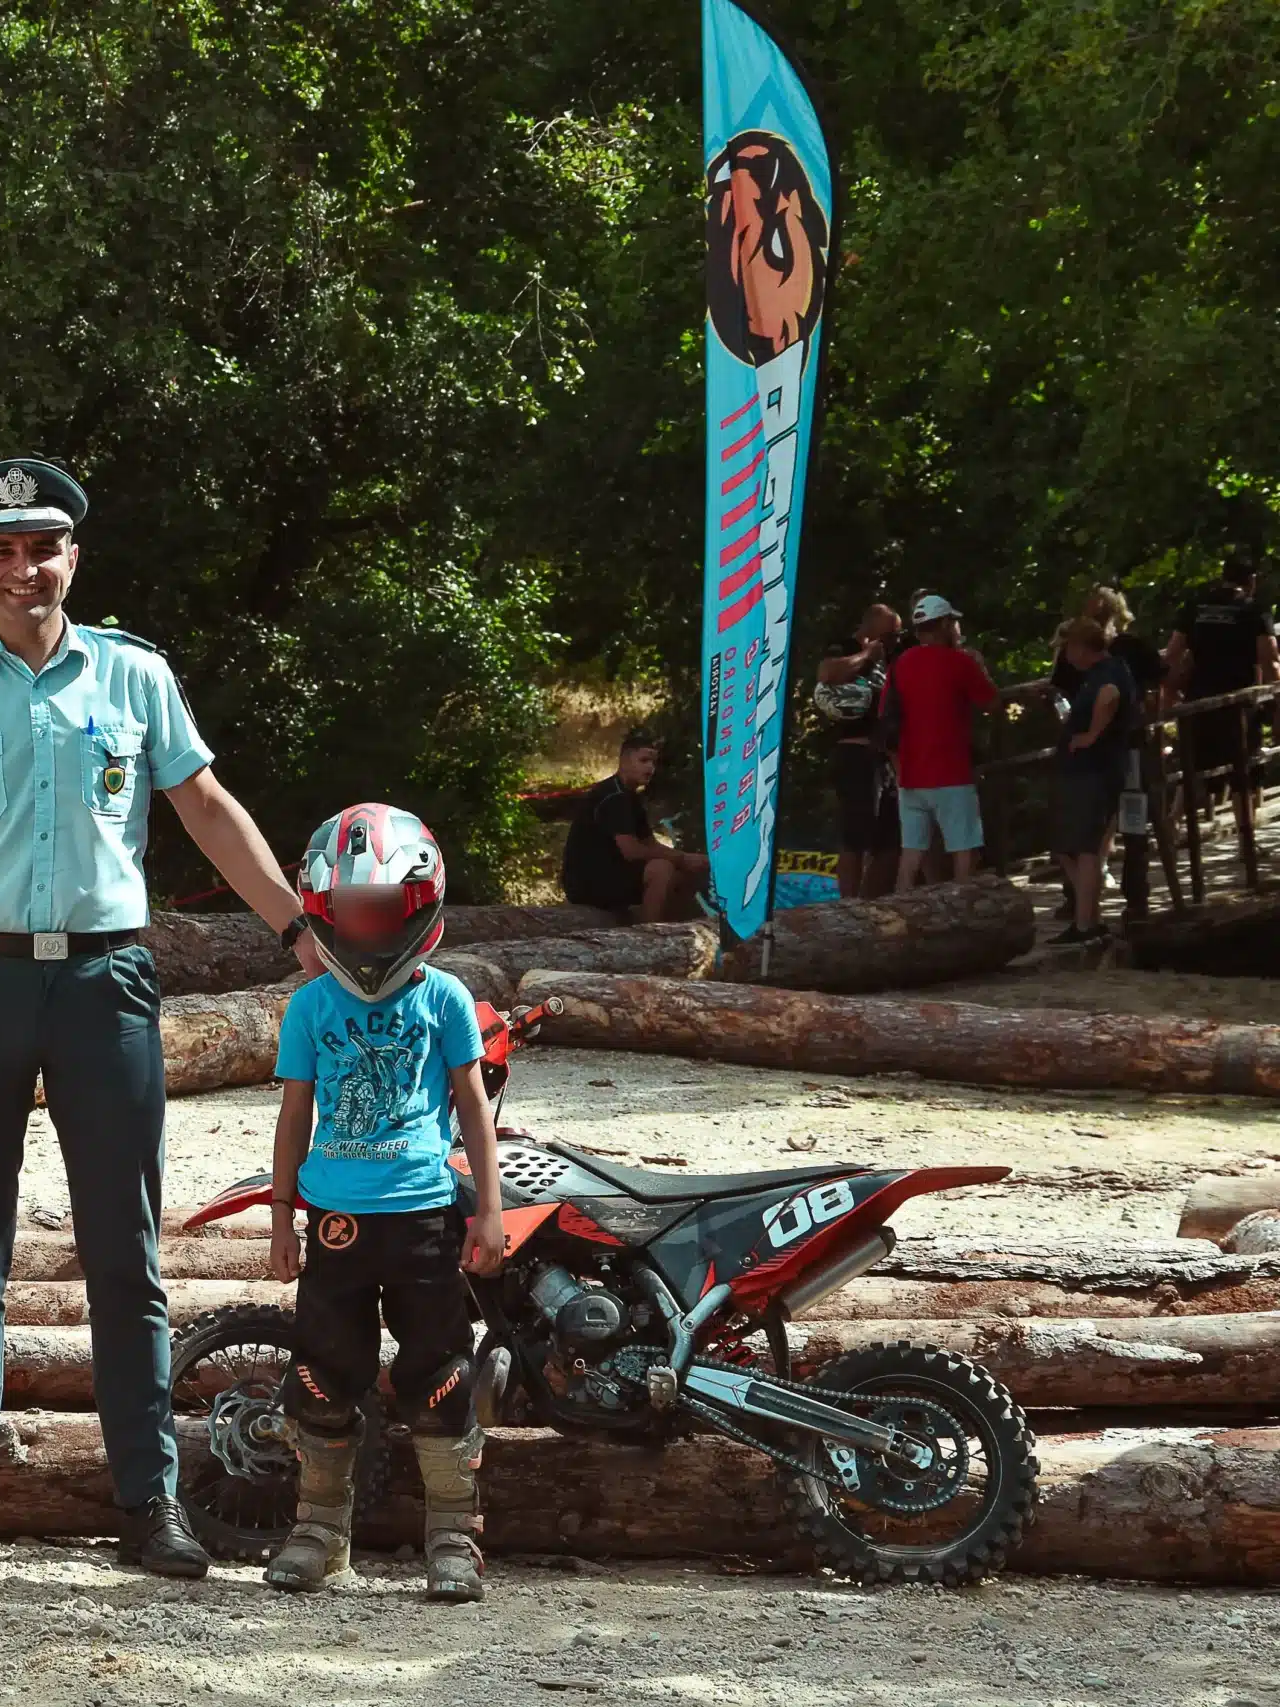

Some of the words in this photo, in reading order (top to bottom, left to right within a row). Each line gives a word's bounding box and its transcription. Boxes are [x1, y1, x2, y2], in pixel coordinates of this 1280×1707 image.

[321, 1010, 425, 1053] RACER
[338, 1140, 368, 1153] WITH
[371, 1140, 409, 1152] SPEED
[375, 1150, 398, 1160] CLUB
[761, 1180, 855, 1249] 08
